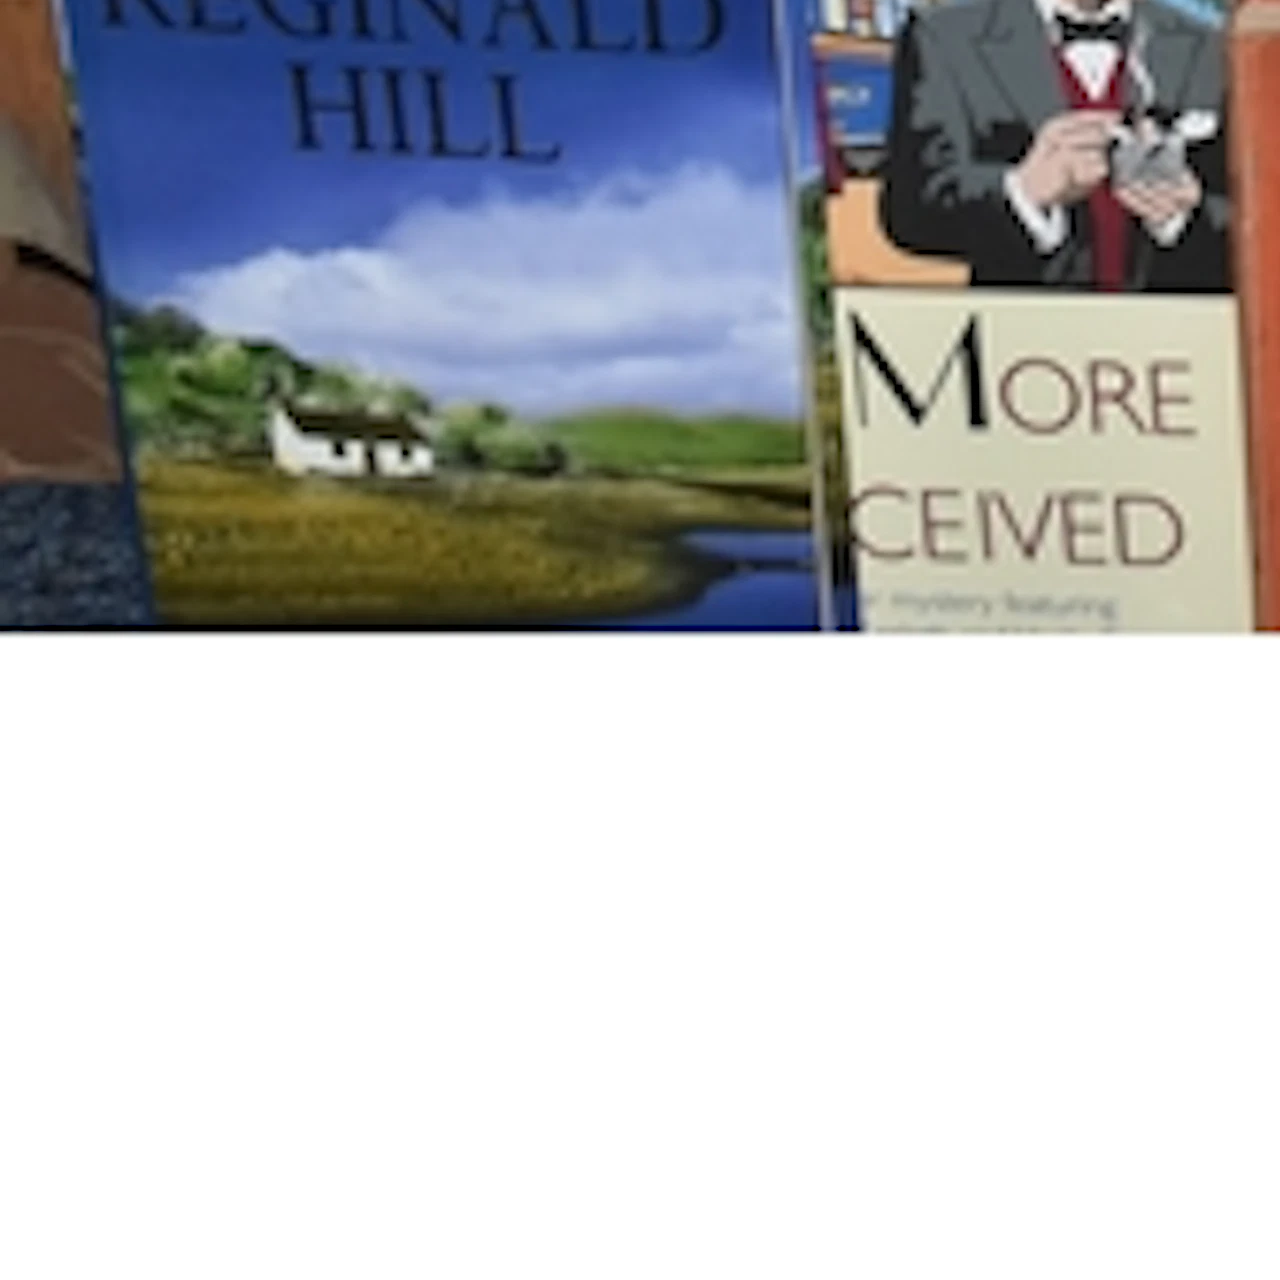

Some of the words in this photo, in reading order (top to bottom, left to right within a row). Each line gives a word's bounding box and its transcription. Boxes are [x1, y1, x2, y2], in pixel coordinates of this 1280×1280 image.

[286, 59, 563, 165] HILL
[847, 310, 1199, 438] MORE
[846, 484, 1184, 568] CEIVED
